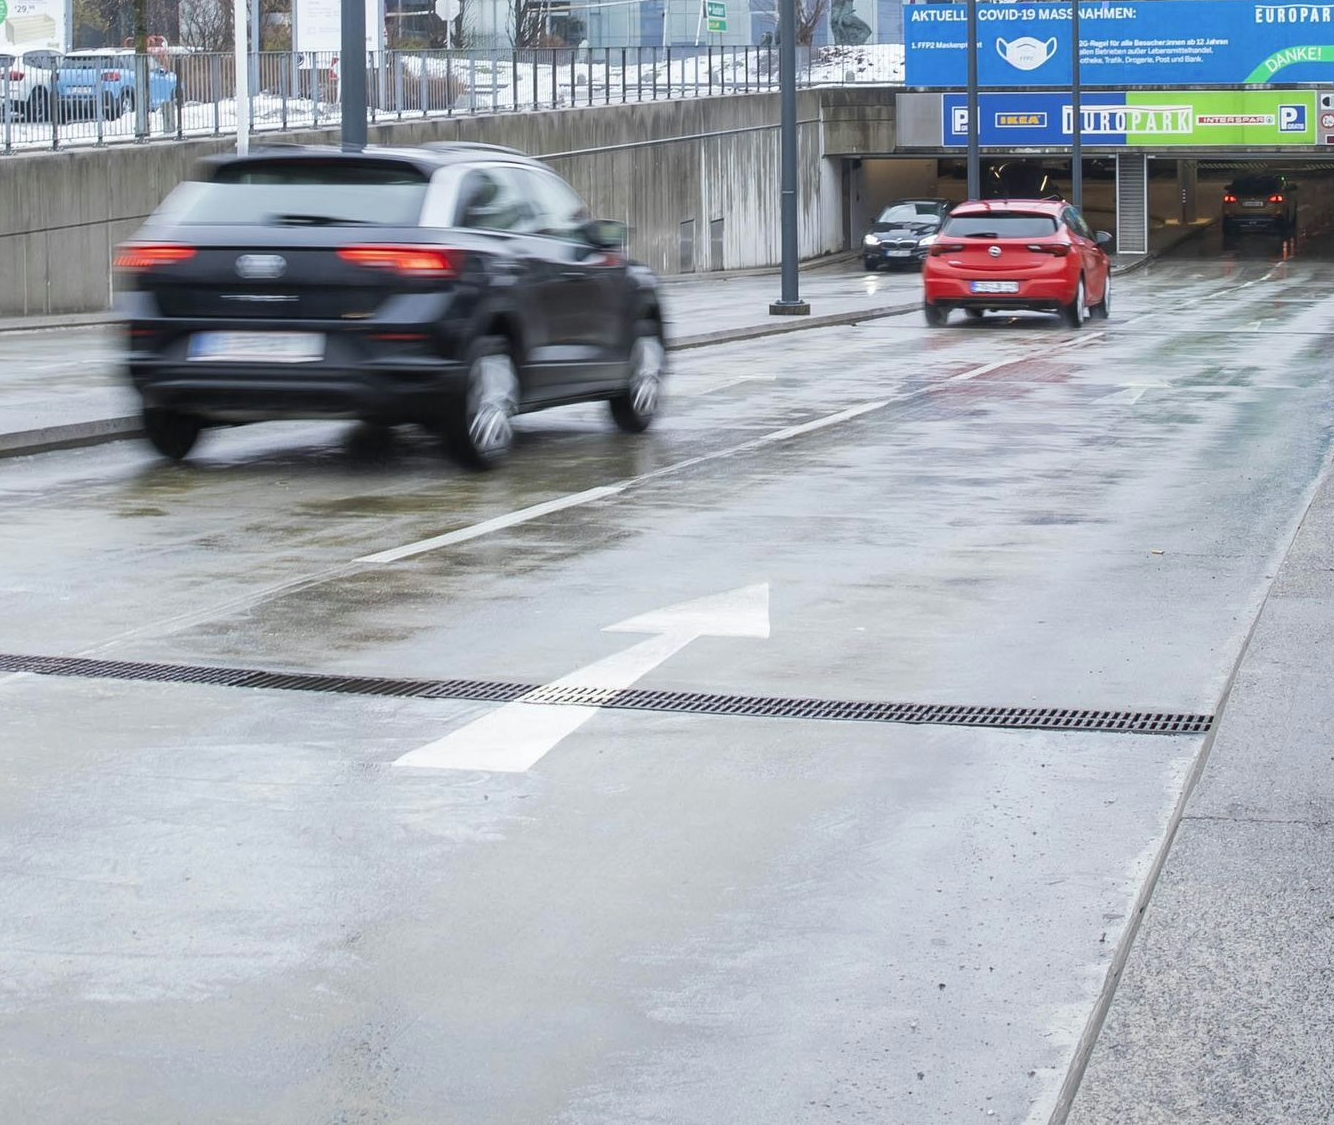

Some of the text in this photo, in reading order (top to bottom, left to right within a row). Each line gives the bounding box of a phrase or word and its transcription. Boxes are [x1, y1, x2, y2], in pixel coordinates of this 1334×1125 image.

[911, 7, 1137, 22] AKTUELL COVID-19 MASSNAHMEN:
[917, 41, 935, 49] FFP2
[1265, 47, 1322, 72] DANKE!
[954, 109, 968, 131] P
[1000, 116, 1040, 124] IKEA
[1280, 107, 1298, 130] P
